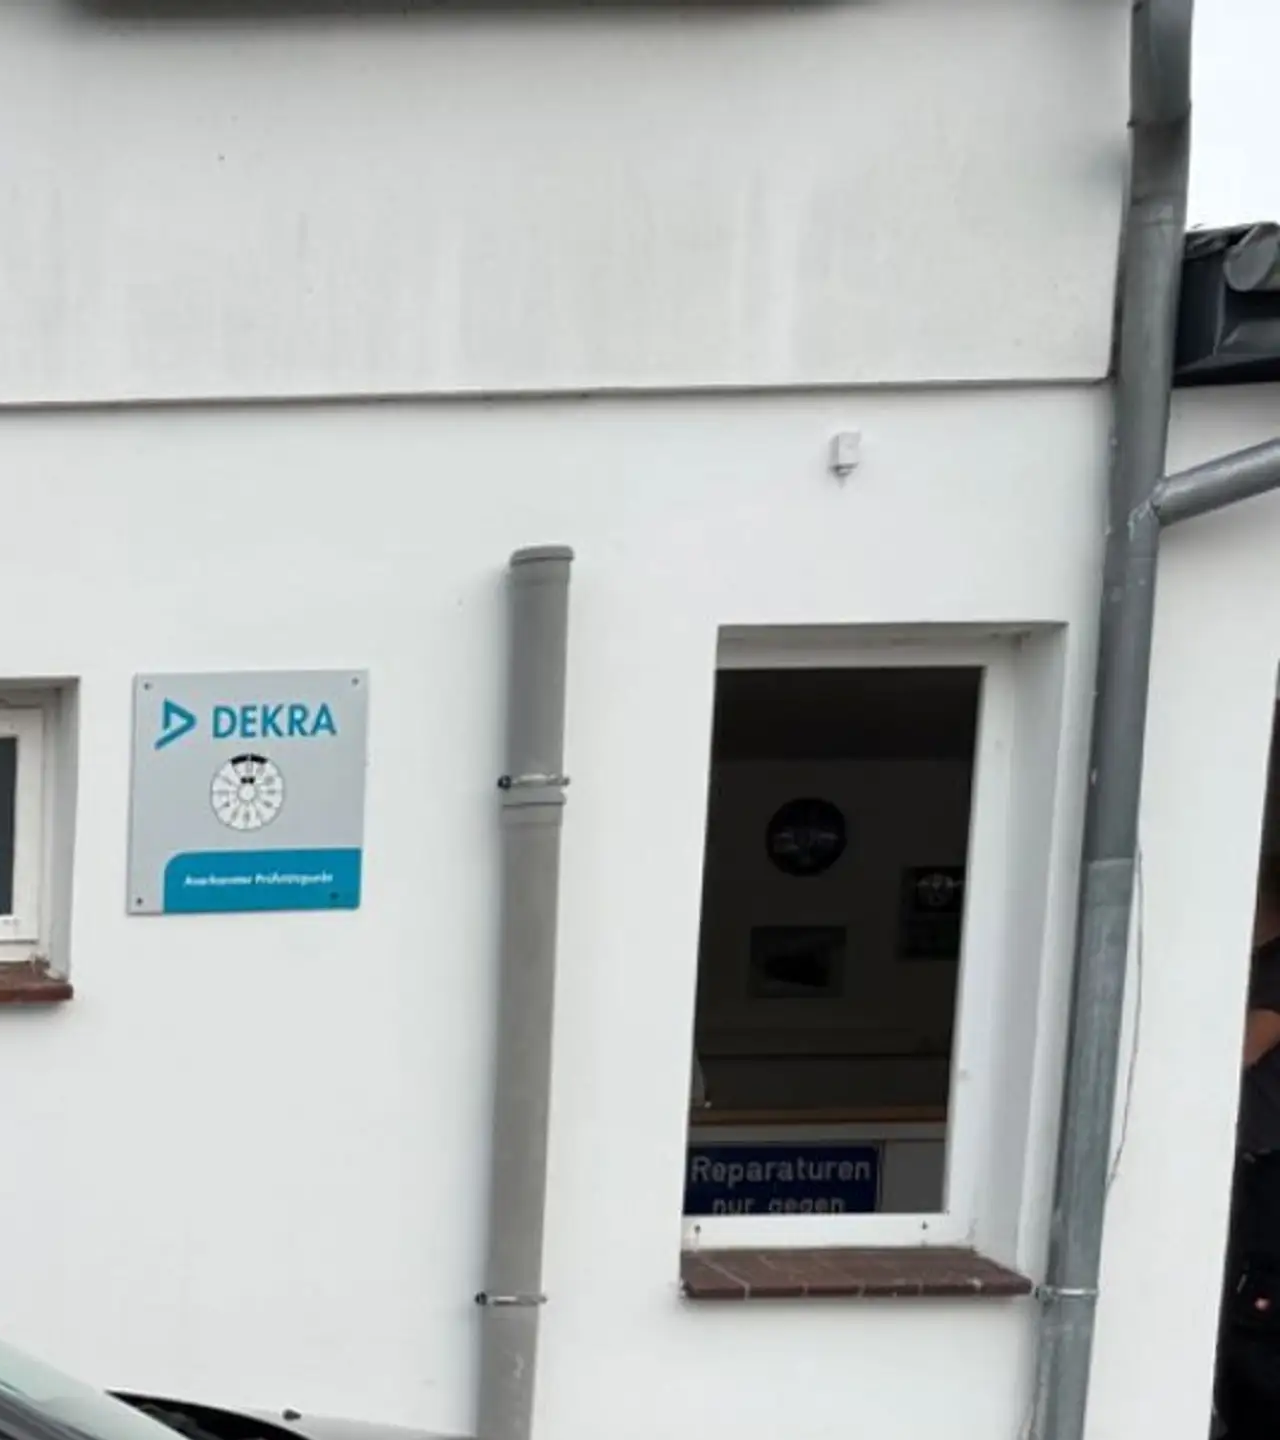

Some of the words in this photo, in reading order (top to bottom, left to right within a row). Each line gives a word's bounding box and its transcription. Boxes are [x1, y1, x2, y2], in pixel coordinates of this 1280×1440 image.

[212, 701, 338, 739] DEKRA
[692, 1155, 871, 1190] Reparaturen
[712, 1198, 756, 1214] nur
